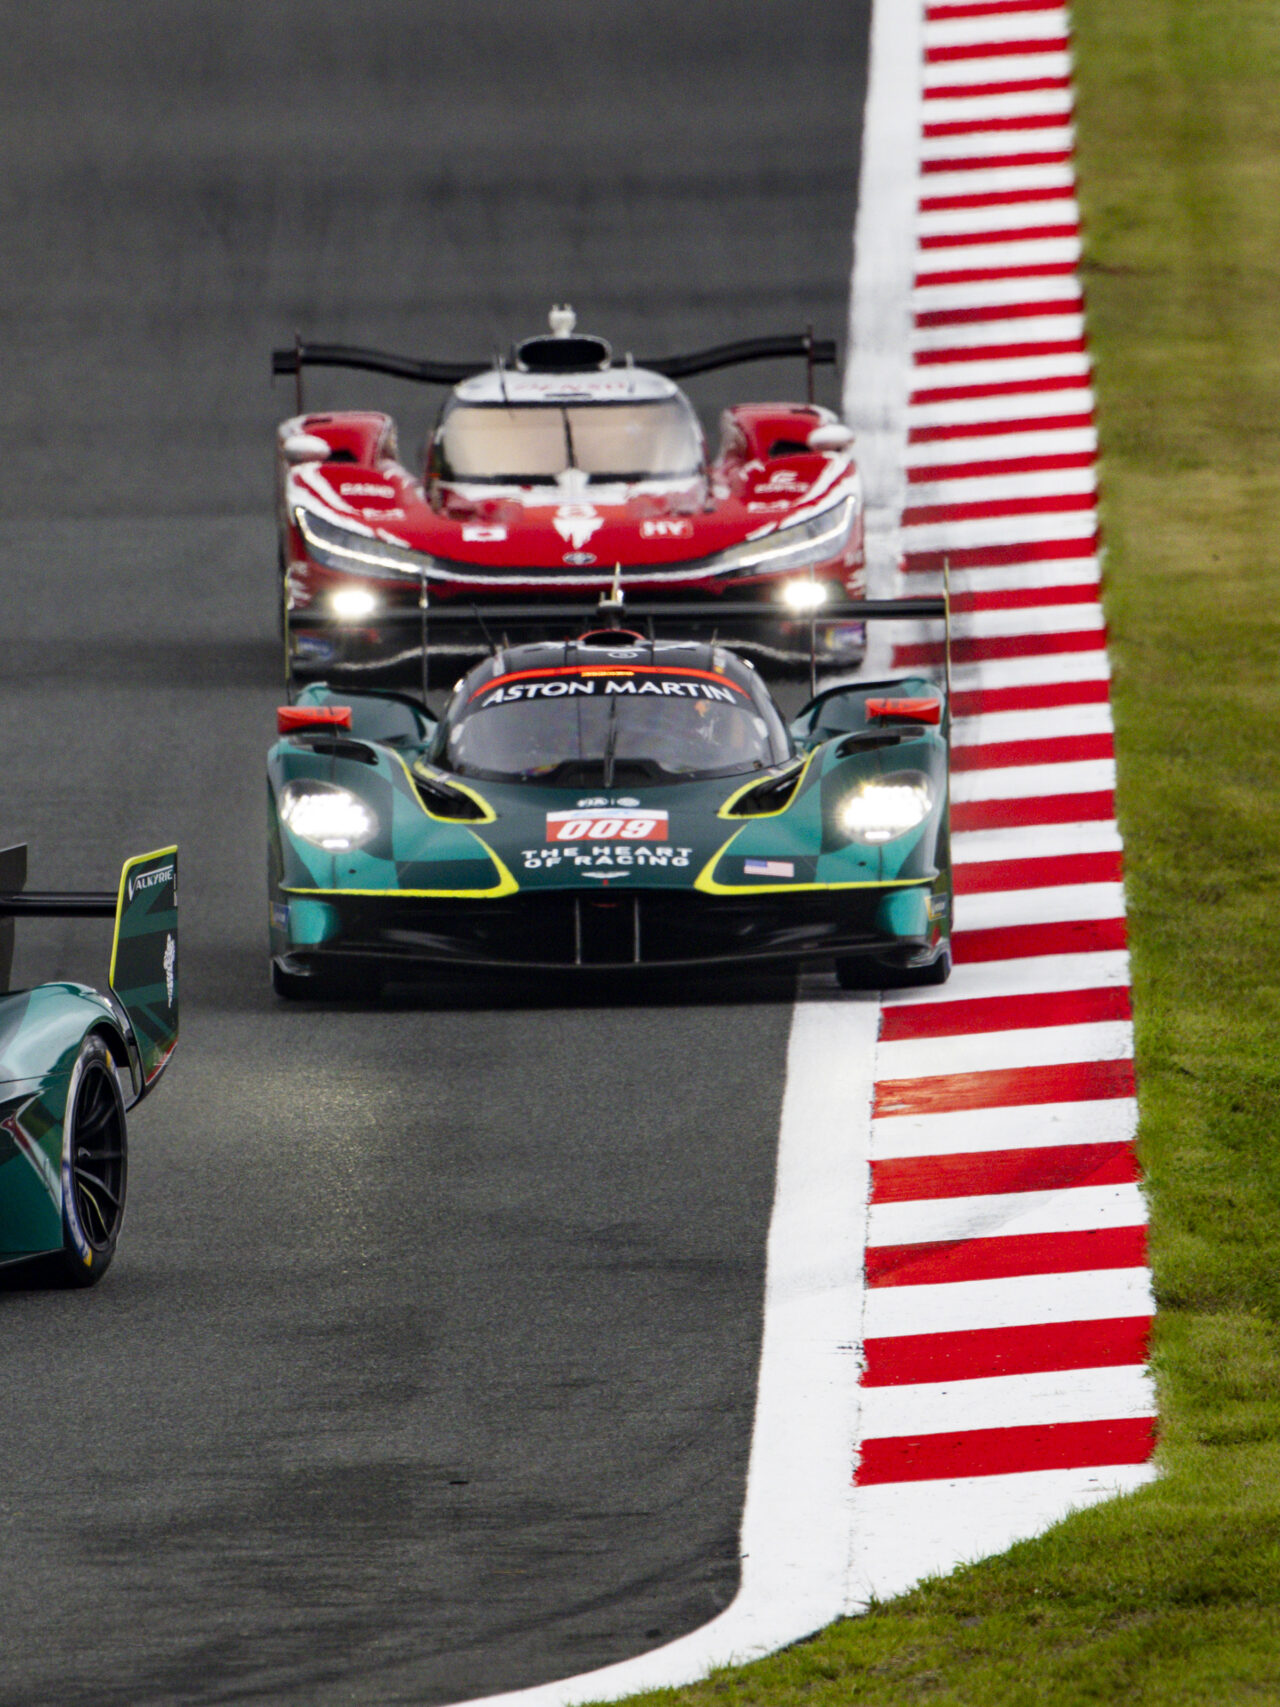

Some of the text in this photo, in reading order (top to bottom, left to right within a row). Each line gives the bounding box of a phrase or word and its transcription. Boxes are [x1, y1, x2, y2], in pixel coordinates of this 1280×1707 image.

[482, 680, 737, 707] ASTON MARTIN
[556, 819, 656, 840] 009
[521, 846, 693, 860] THE HEART
[524, 855, 690, 869] OF RACING
[128, 864, 174, 901] VALKYRIE
